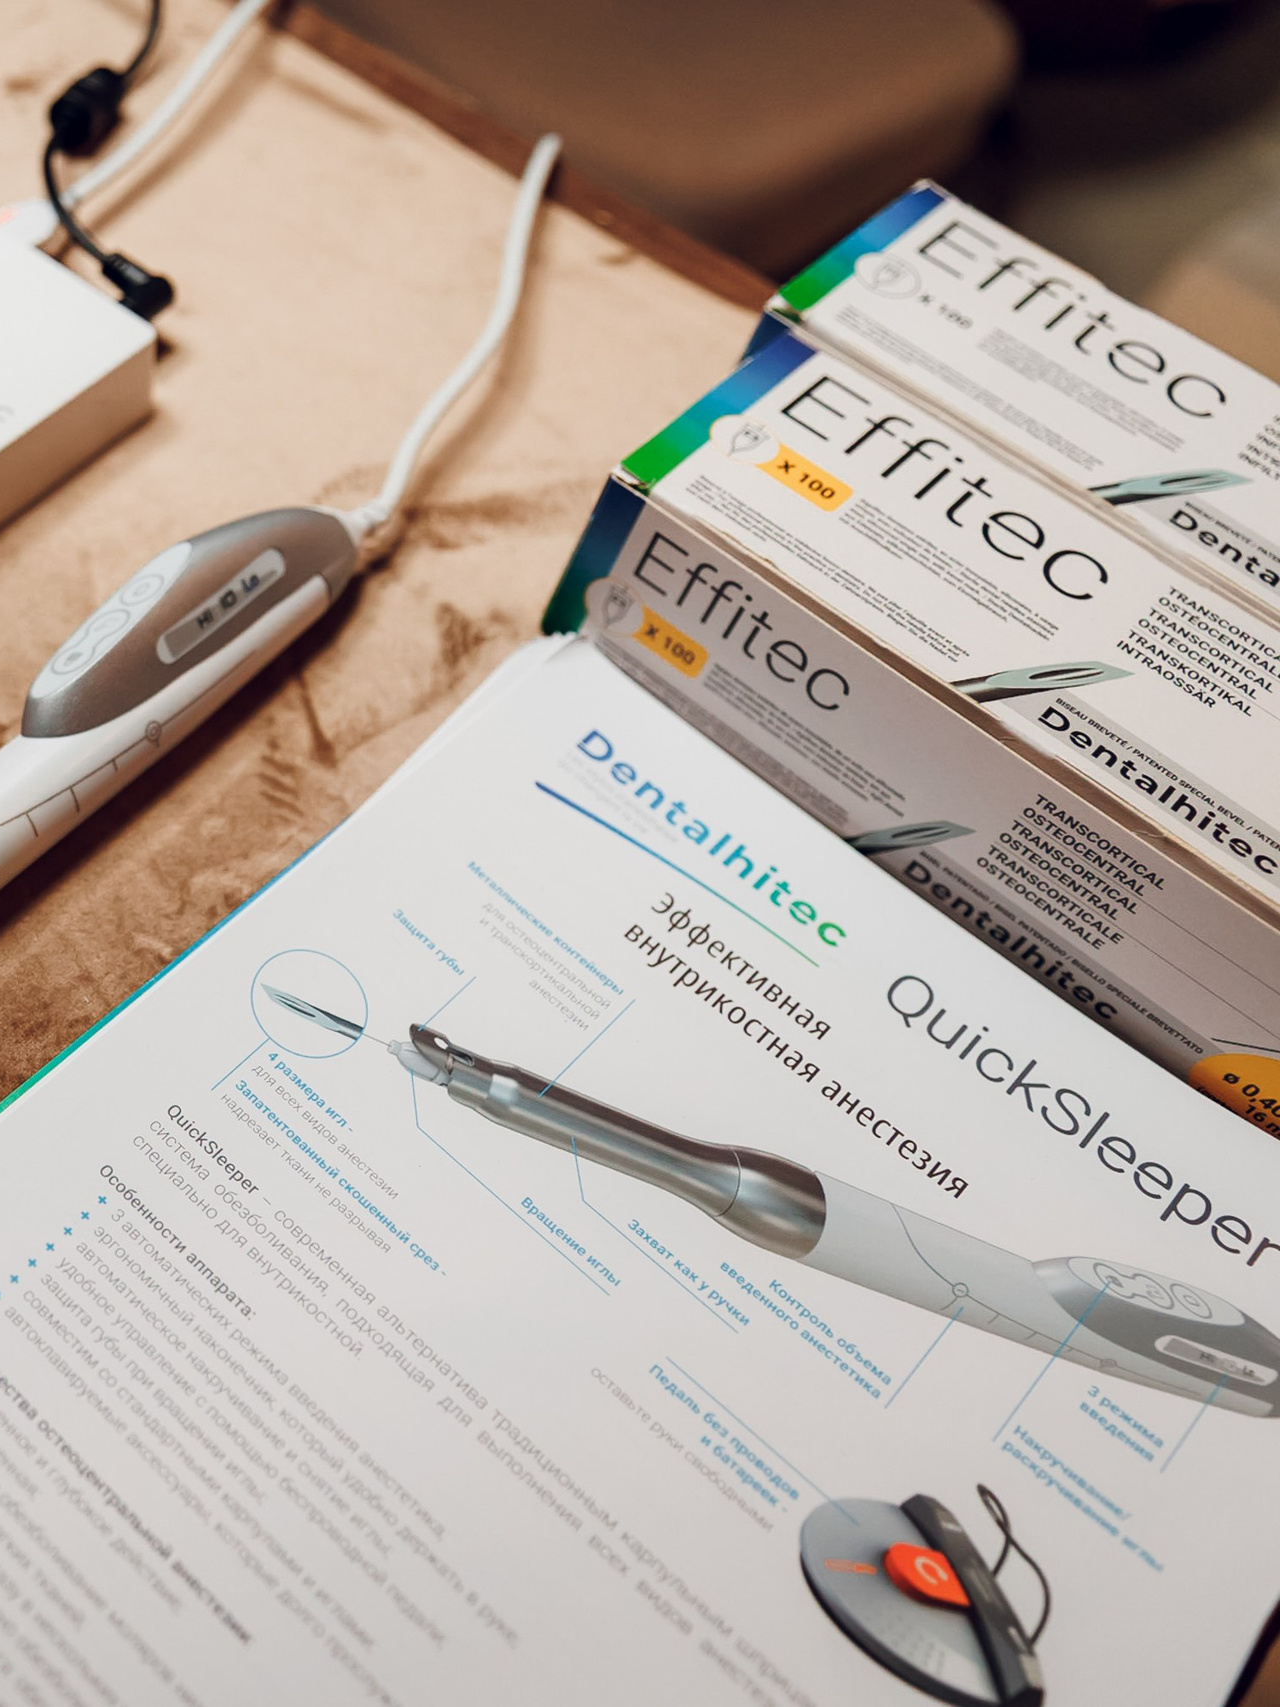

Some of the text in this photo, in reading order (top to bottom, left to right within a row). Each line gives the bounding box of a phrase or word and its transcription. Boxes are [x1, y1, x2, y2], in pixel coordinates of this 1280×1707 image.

[917, 220, 1227, 419] Effitec
[780, 375, 1109, 601] Effitec
[799, 472, 836, 500] 100
[632, 530, 850, 711] Effitec
[663, 635, 696, 666] 100
[1115, 639, 1217, 708] INTRAOSSÄR
[1128, 629, 1252, 717] TRANSKORTIKAL
[1137, 618, 1257, 700] OSTEOCENTRAL
[1148, 607, 1273, 694] TRANSCORTICAL
[1158, 596, 1280, 680] OSTÉOCENTRAL
[1037, 705, 1278, 875] Dentalhitec
[1054, 697, 1089, 721] BISEAU
[1131, 747, 1179, 782] PATENTED
[1177, 779, 1215, 808] SPECIAL
[1216, 804, 1245, 828] BEVEL
[576, 729, 847, 948] Dentalhitec
[987, 844, 1125, 945] TRANSCORTICALE
[998, 831, 1118, 921] OSTEOCENTRAL
[1011, 819, 1137, 915] TRANSCORTICAL
[1022, 806, 1145, 897] OSTEOCENTRAL
[1035, 793, 1165, 891] TRANSCORTICAL
[392, 908, 465, 976] Защита губы
[467, 860, 624, 996] Металлические контейнеры
[480, 902, 612, 1010] для остеоцентральной
[903, 859, 1119, 1021] Dentalhitec
[975, 856, 1106, 950] OSTEOCENTRALE
[489, 925, 601, 1021] транскортикальной
[527, 979, 590, 1031] анестезии
[651, 892, 832, 1041] Эффективная
[1070, 957, 1107, 986] BISELLO
[1104, 982, 1148, 1015] SPECIALE
[1145, 1012, 1204, 1055] BREVETTATO
[267, 1052, 348, 1128] 4 размера игл
[623, 923, 969, 1199] внутрикостная анестезия
[886, 974, 1280, 1266] QuickSleeper
[1246, 1104, 1267, 1122] 16
[219, 1093, 392, 1254] надрезает ткани не разрывая
[234, 1079, 440, 1271] Запатентованный скошенный срез
[250, 1064, 399, 1200] для всех видов анестезии
[99, 1164, 256, 1317] Особенности аппарата:
[132, 1135, 364, 1357] специально для внутрикостной.
[148, 1119, 210, 1181] система
[213, 1183, 329, 1298] обезболивания,
[334, 1297, 436, 1393] подходящая
[435, 1395, 473, 1428] для
[520, 1196, 621, 1287] Вращение иглы
[627, 1218, 750, 1326] Захват как у ручки
[3, 1306, 128, 1433] автоклавируемые
[22, 1289, 100, 1370] совместим
[96, 1366, 118, 1389] со
[40, 1273, 93, 1328] защита
[89, 1324, 127, 1363] губы
[124, 1359, 155, 1391] при
[54, 1256, 116, 1316] удобное
[109, 1312, 197, 1397] управление
[75, 1241, 187, 1353] автоматическое
[184, 1350, 286, 1450] накручивание
[92, 1225, 195, 1327] эргономичный
[191, 1323, 277, 1412] наконечник,
[277, 1407, 345, 1474] который
[120, 1220, 233, 1331] автоматических
[227, 1327, 289, 1386] режима
[287, 1383, 360, 1454] введения
[166, 1104, 260, 1194] QuickSleeper
[273, 1209, 377, 1306] современная
[376, 1304, 489, 1411] альтернатива
[491, 1408, 619, 1532] традиционным
[719, 1261, 881, 1400] введенного анестетика
[767, 1278, 892, 1386] Контроль объема
[590, 1367, 774, 1533] оставьте руки свободными
[648, 1363, 800, 1501] Педаль без проводов
[699, 1434, 780, 1507] и батареек
[1078, 1401, 1155, 1462] введения
[1086, 1384, 1164, 1449] 3 режима
[36, 1419, 173, 1562] остеоцентральной
